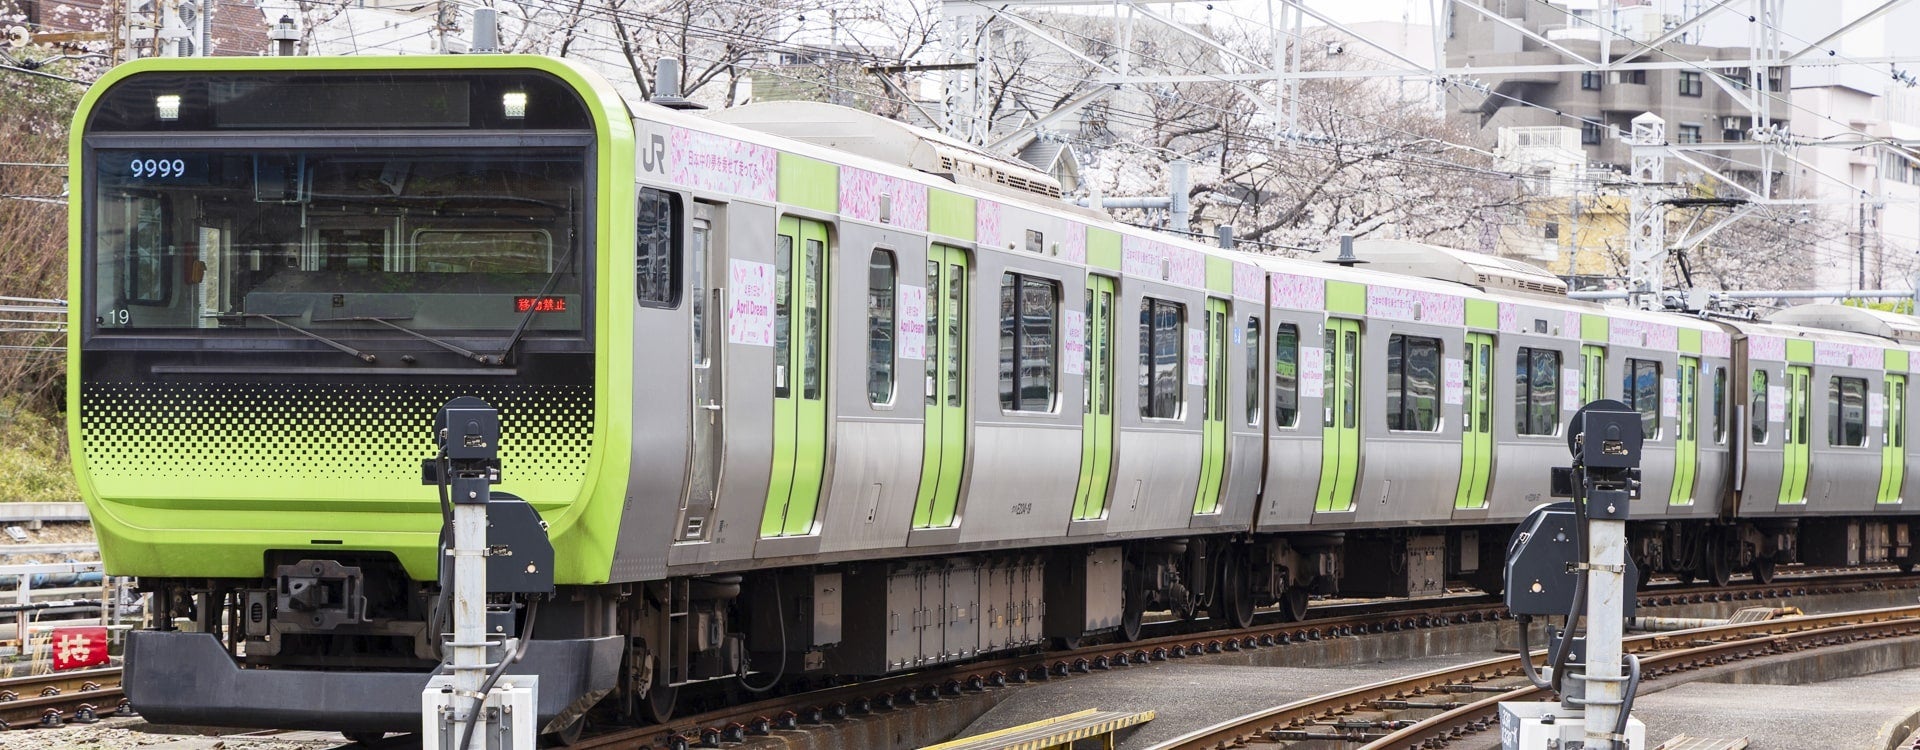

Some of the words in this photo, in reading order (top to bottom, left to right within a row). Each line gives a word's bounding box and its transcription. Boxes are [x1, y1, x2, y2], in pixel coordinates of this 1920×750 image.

[643, 133, 665, 174] JR
[130, 159, 185, 179] 9999
[107, 309, 130, 325] 19
[736, 299, 749, 317] April
[750, 301, 768, 317] Dream
